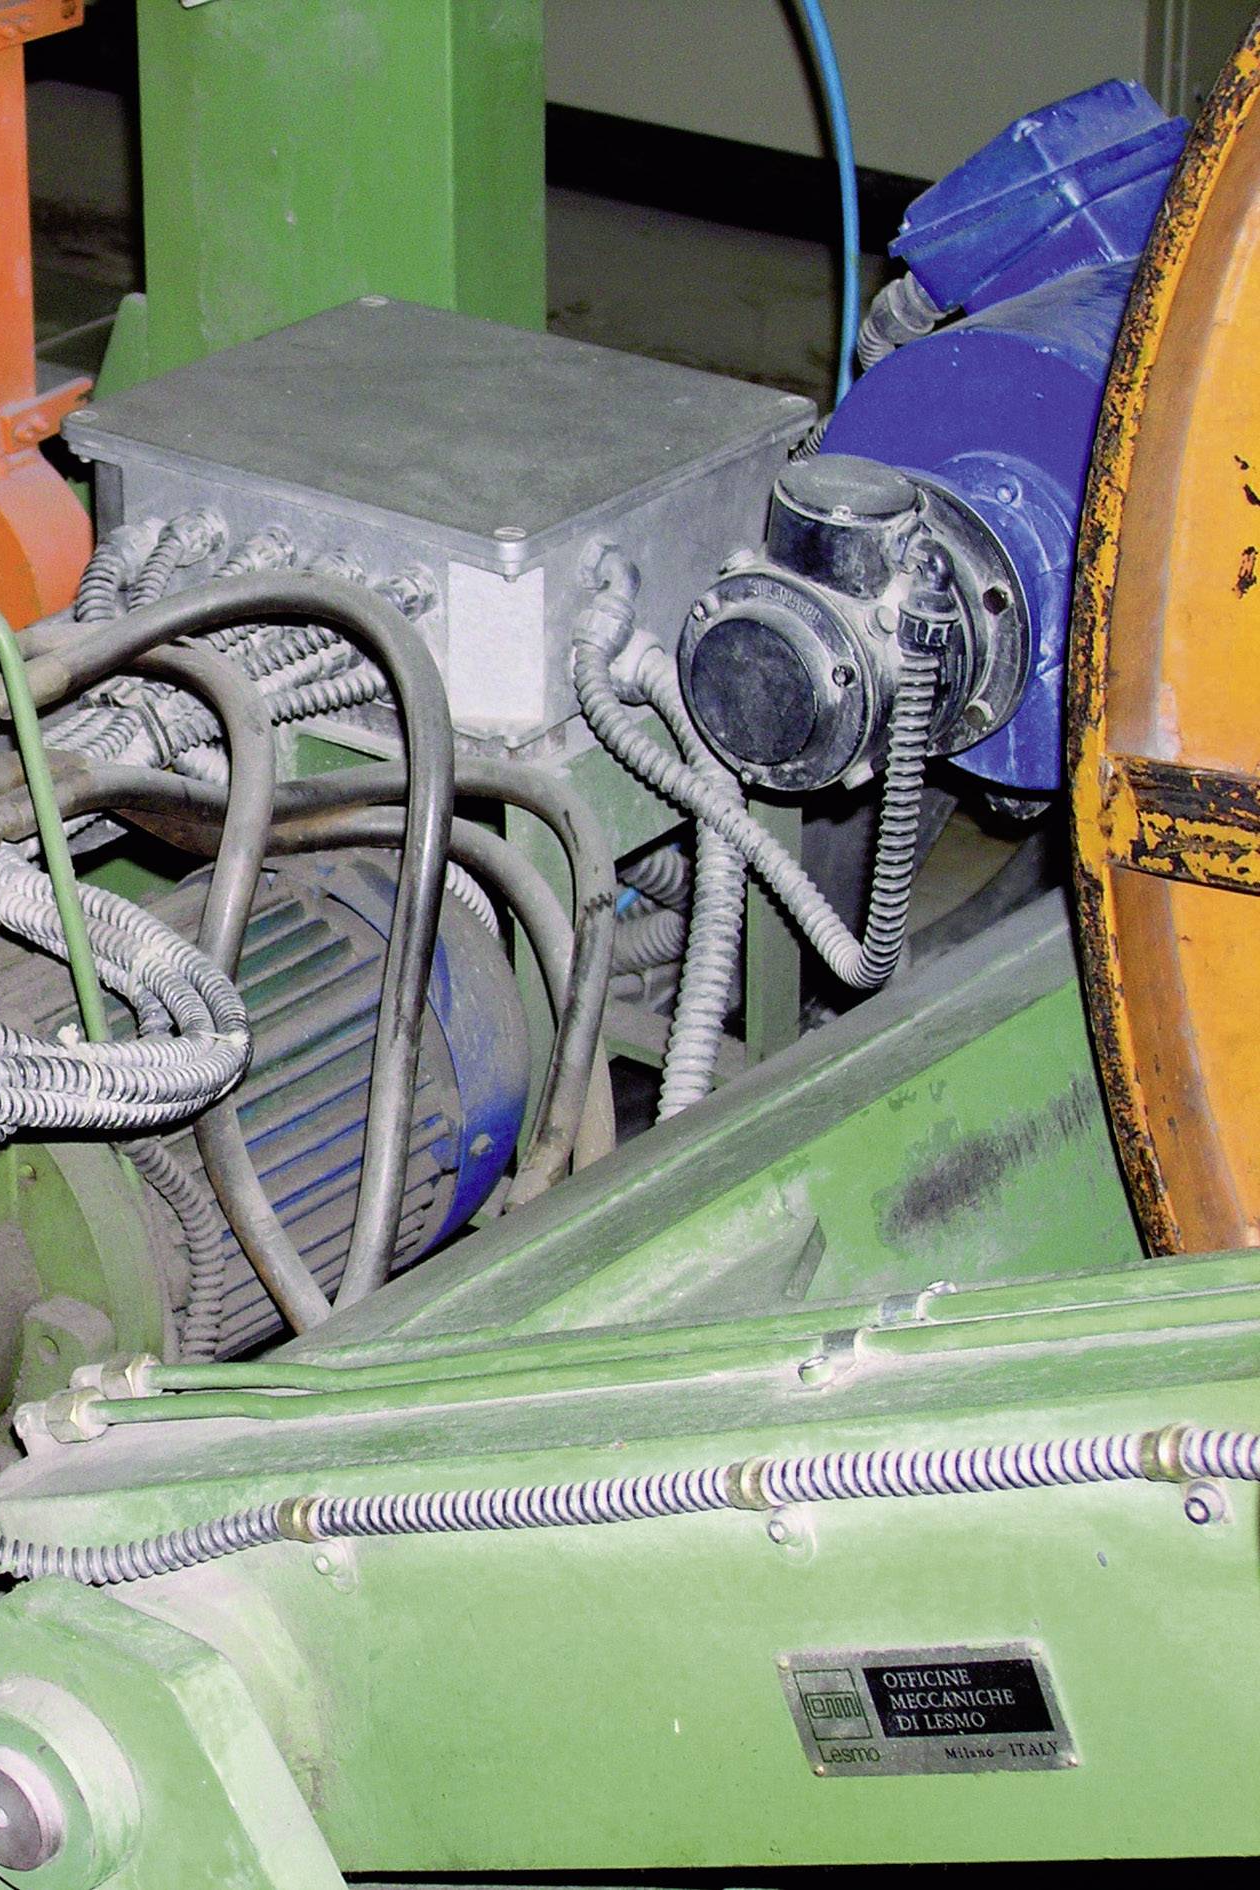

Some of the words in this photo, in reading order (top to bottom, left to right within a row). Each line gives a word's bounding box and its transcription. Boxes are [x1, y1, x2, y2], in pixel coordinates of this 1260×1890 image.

[882, 1669, 972, 1688] OFFICINE
[889, 1688, 1016, 1710] MECCANICHE
[895, 1714, 920, 1731] DI
[923, 1711, 986, 1730] LESMO
[818, 1744, 881, 1763] Lesmo
[1008, 1740, 1058, 1757] ITALY
